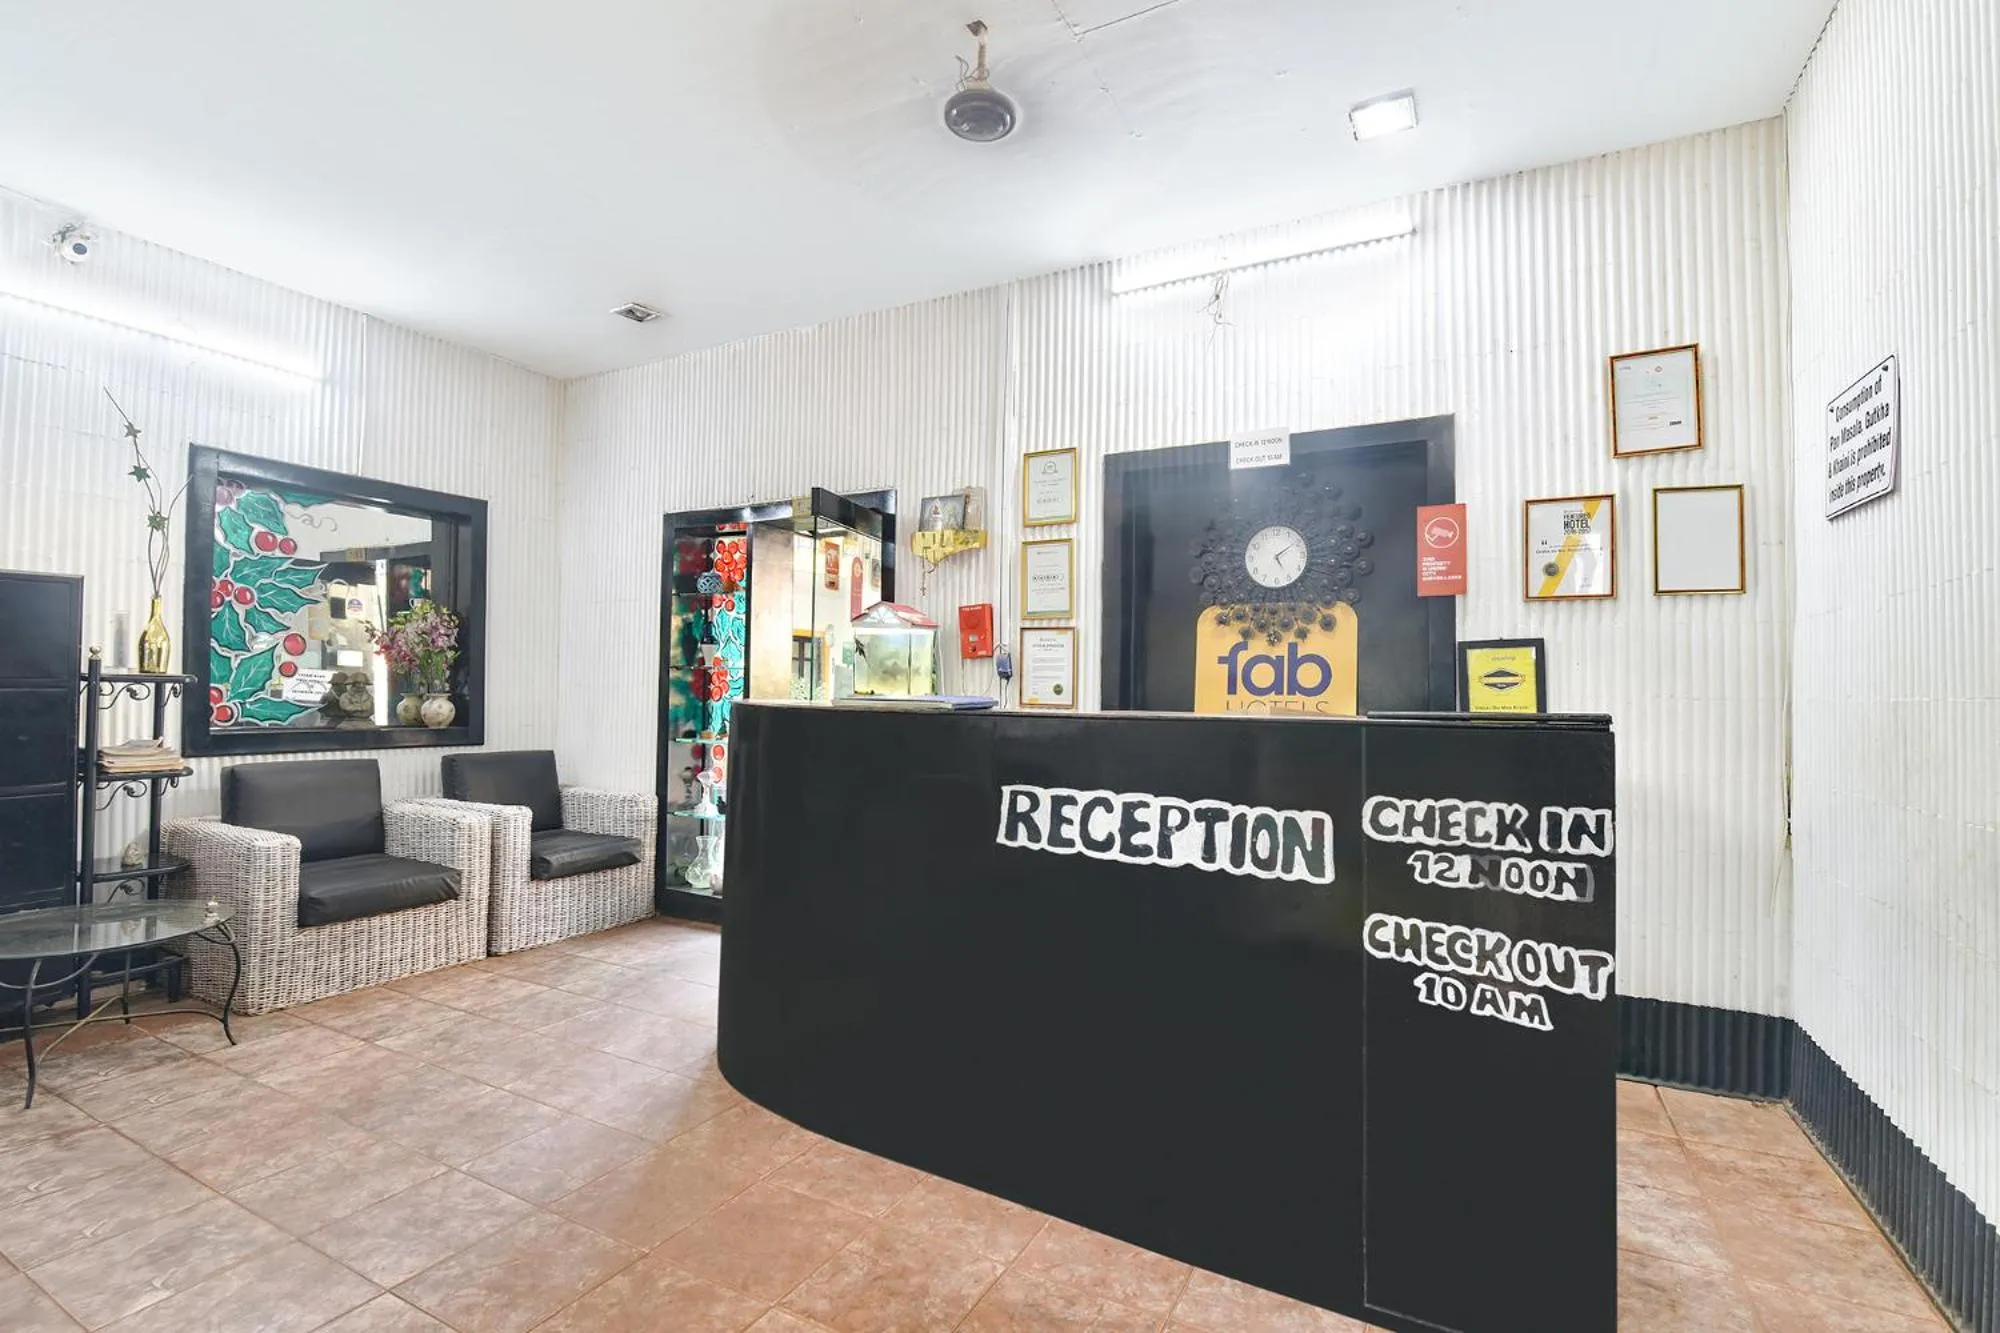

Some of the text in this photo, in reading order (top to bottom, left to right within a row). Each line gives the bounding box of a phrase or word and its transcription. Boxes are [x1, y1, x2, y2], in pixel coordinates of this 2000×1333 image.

[1835, 374, 1882, 423] Consumption of
[1865, 402, 1889, 430] Gutkha
[1850, 448, 1856, 466] is
[1857, 427, 1891, 467] prohibited
[1844, 474, 1856, 497] this
[1272, 528, 1281, 537] 12
[1563, 519, 1591, 529] HOTEL
[1262, 574, 1268, 582] 7
[1274, 577, 1280, 585] 6
[1217, 640, 1333, 697] fab
[996, 785, 1335, 884] RECEPTION
[1362, 795, 1614, 857] CHECK IN
[1407, 850, 1595, 902] 12 NOON
[1363, 913, 1615, 1001] CHECK OUT
[1413, 972, 1554, 1031] 10 AM
